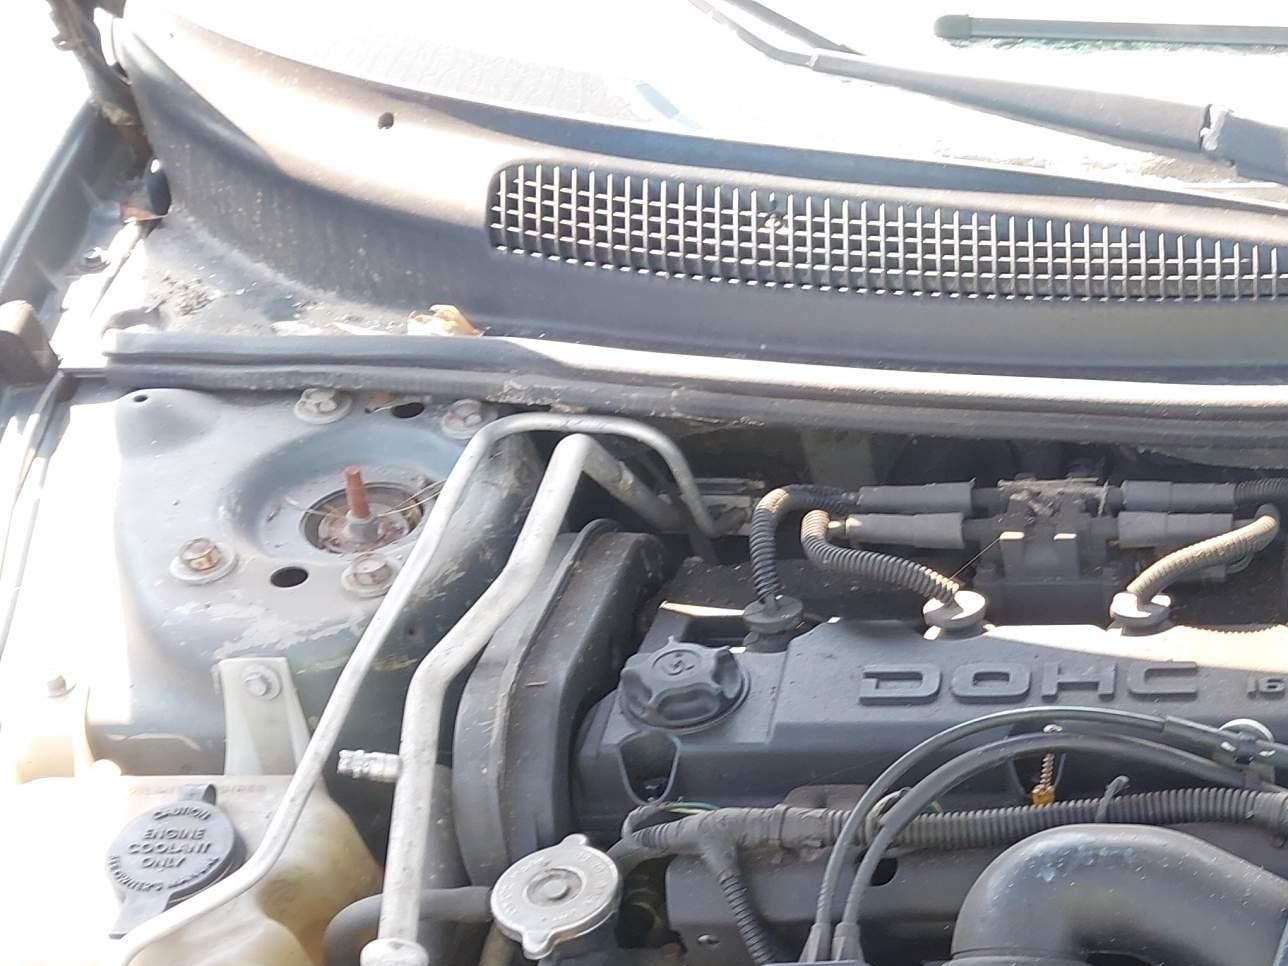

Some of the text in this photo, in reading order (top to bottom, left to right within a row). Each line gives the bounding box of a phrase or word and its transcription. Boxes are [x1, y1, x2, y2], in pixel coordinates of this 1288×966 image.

[859, 659, 1199, 705] DOHC
[152, 806, 212, 821] CAUTION
[142, 827, 208, 841] ENGINE
[127, 841, 213, 855] COOLANT
[141, 855, 187, 870] ONLY
